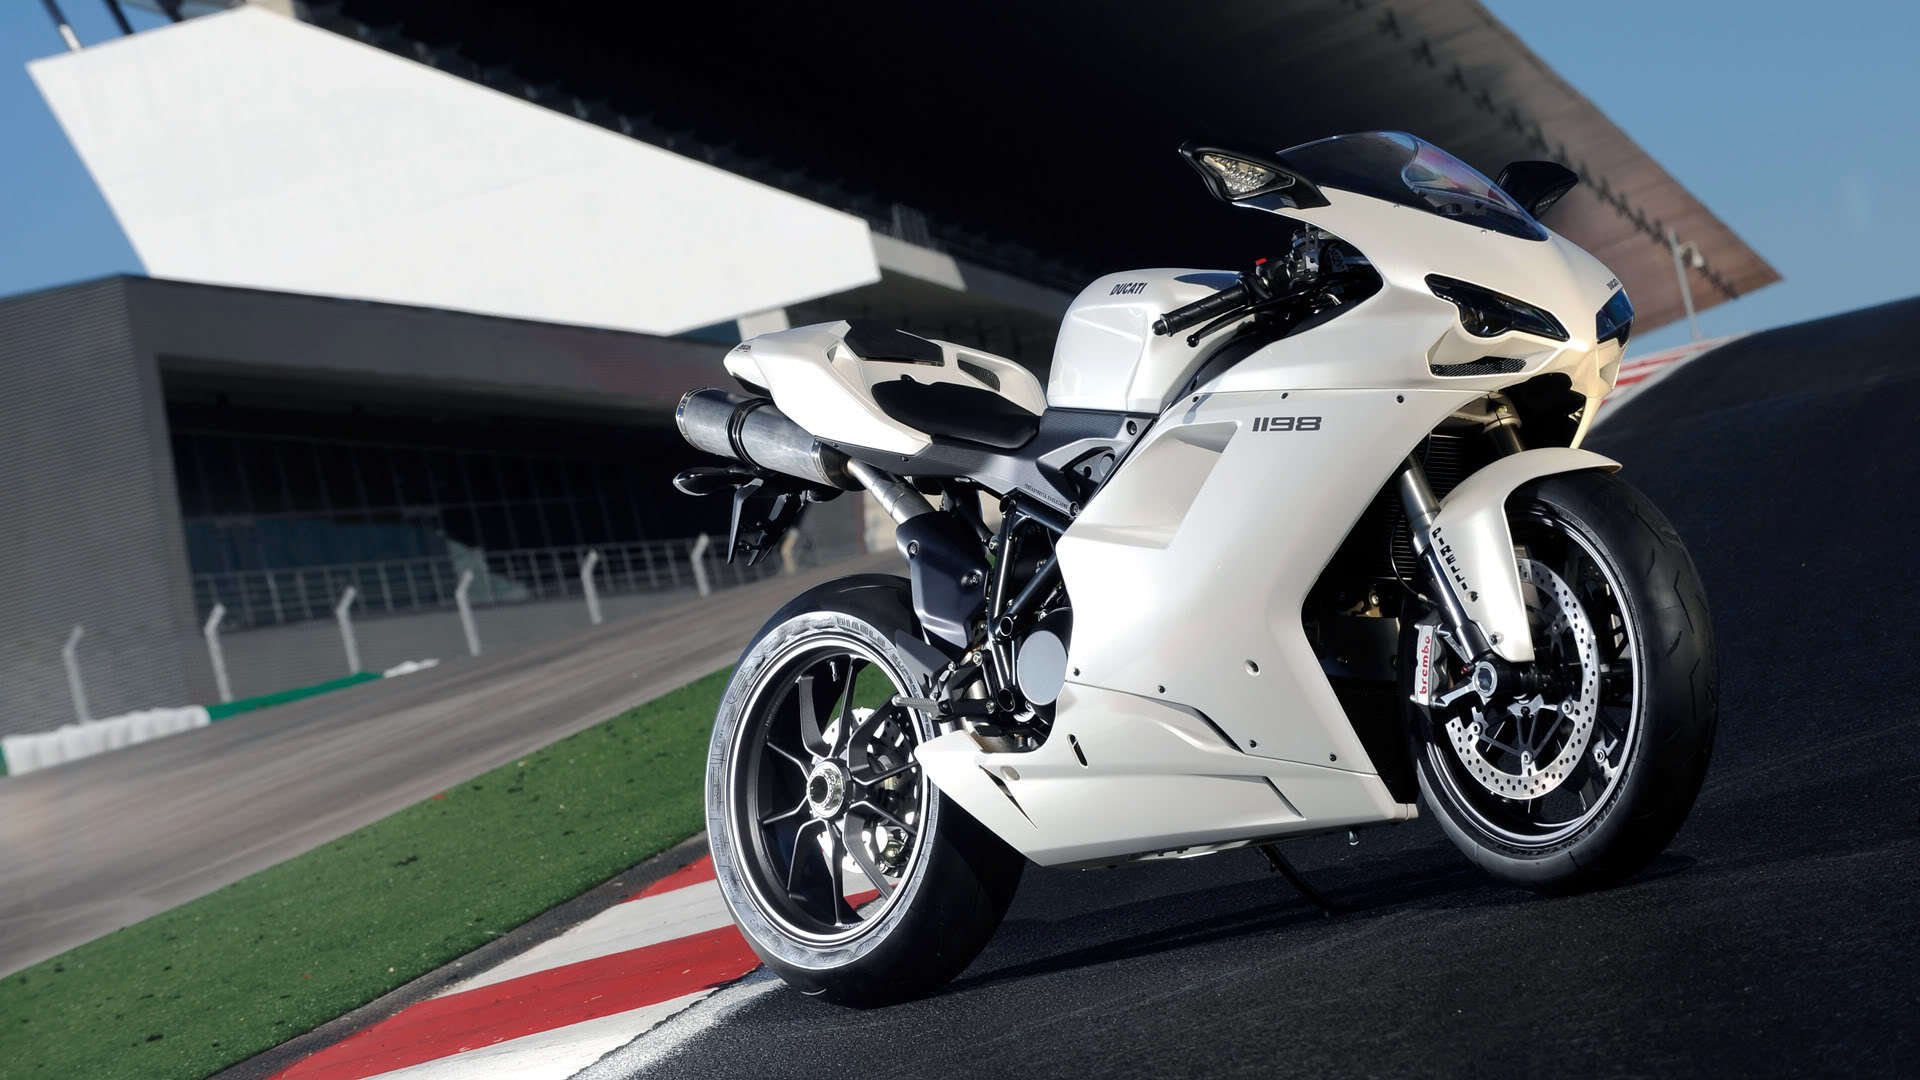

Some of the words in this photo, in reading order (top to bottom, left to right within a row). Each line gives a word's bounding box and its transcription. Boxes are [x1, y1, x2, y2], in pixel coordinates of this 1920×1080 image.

[1109, 282, 1148, 296] DUCATI
[1252, 416, 1322, 432] 1198
[1432, 527, 1468, 591] PIRELLI
[1419, 636, 1431, 695] brembo
